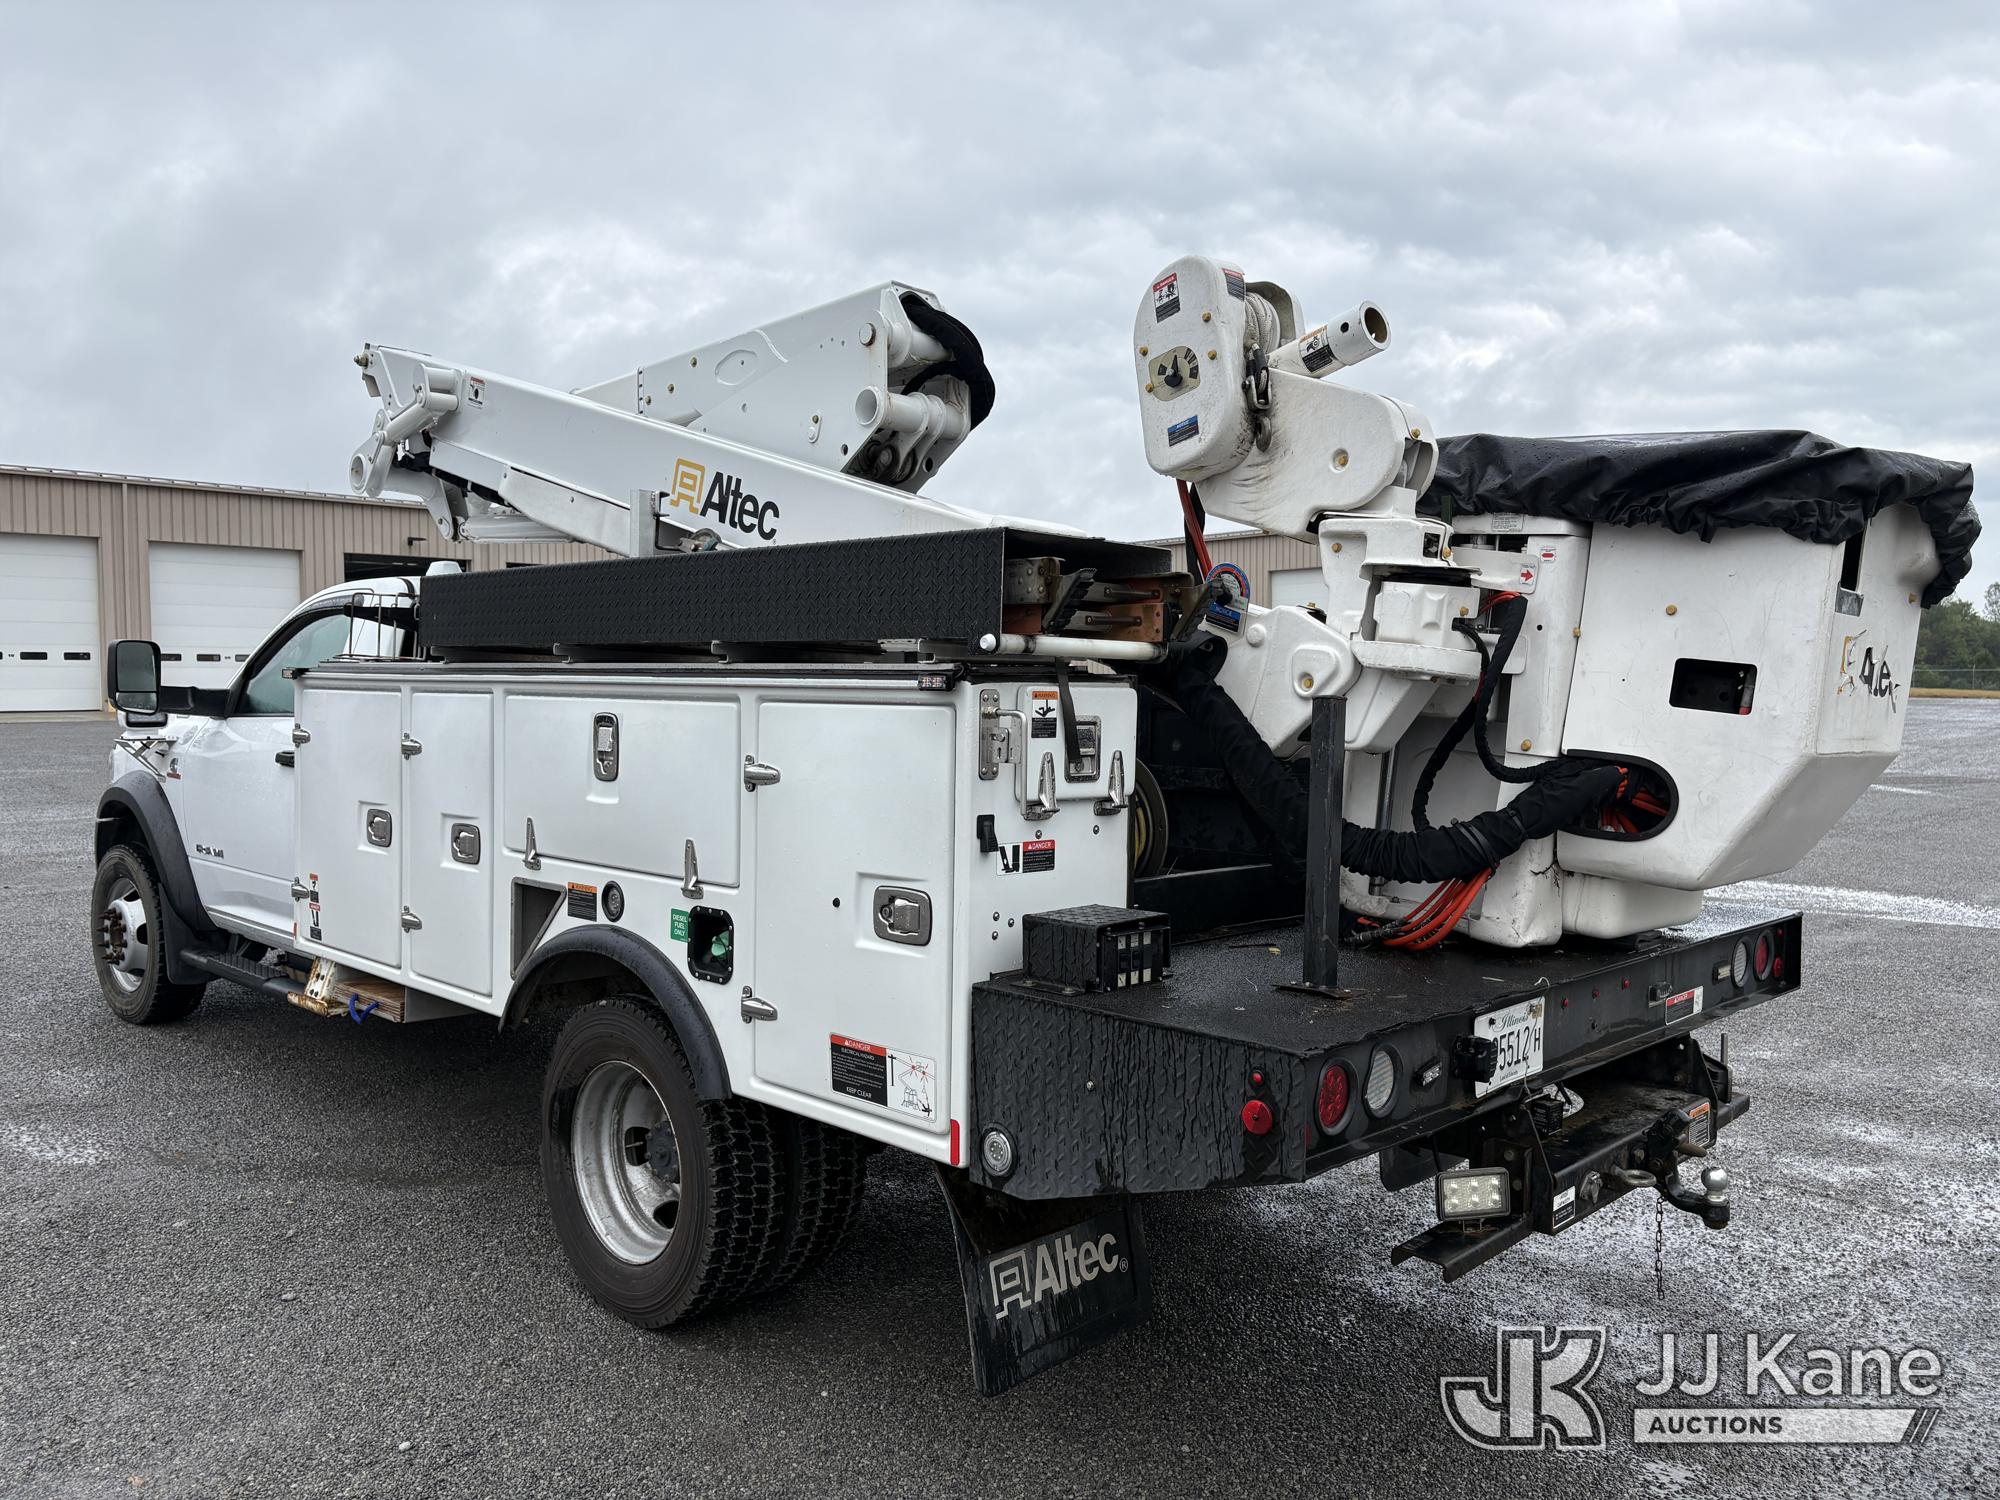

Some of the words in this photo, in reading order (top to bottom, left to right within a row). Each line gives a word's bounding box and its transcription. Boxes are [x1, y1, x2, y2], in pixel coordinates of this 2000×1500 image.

[700, 471, 780, 541] Altec
[1032, 842, 1052, 850] DANGER
[672, 914, 688, 923] DIESEL
[674, 921, 685, 930] FUEL
[673, 928, 686, 937] ONLY
[1492, 1013, 1529, 1033] Illinois
[848, 1040, 871, 1052] DANGER
[841, 1047, 860, 1057] ELECTRICAL
[846, 1086, 857, 1094] KEEP
[856, 1089, 872, 1099] CLEAR
[1034, 1233, 1119, 1304] Altec
